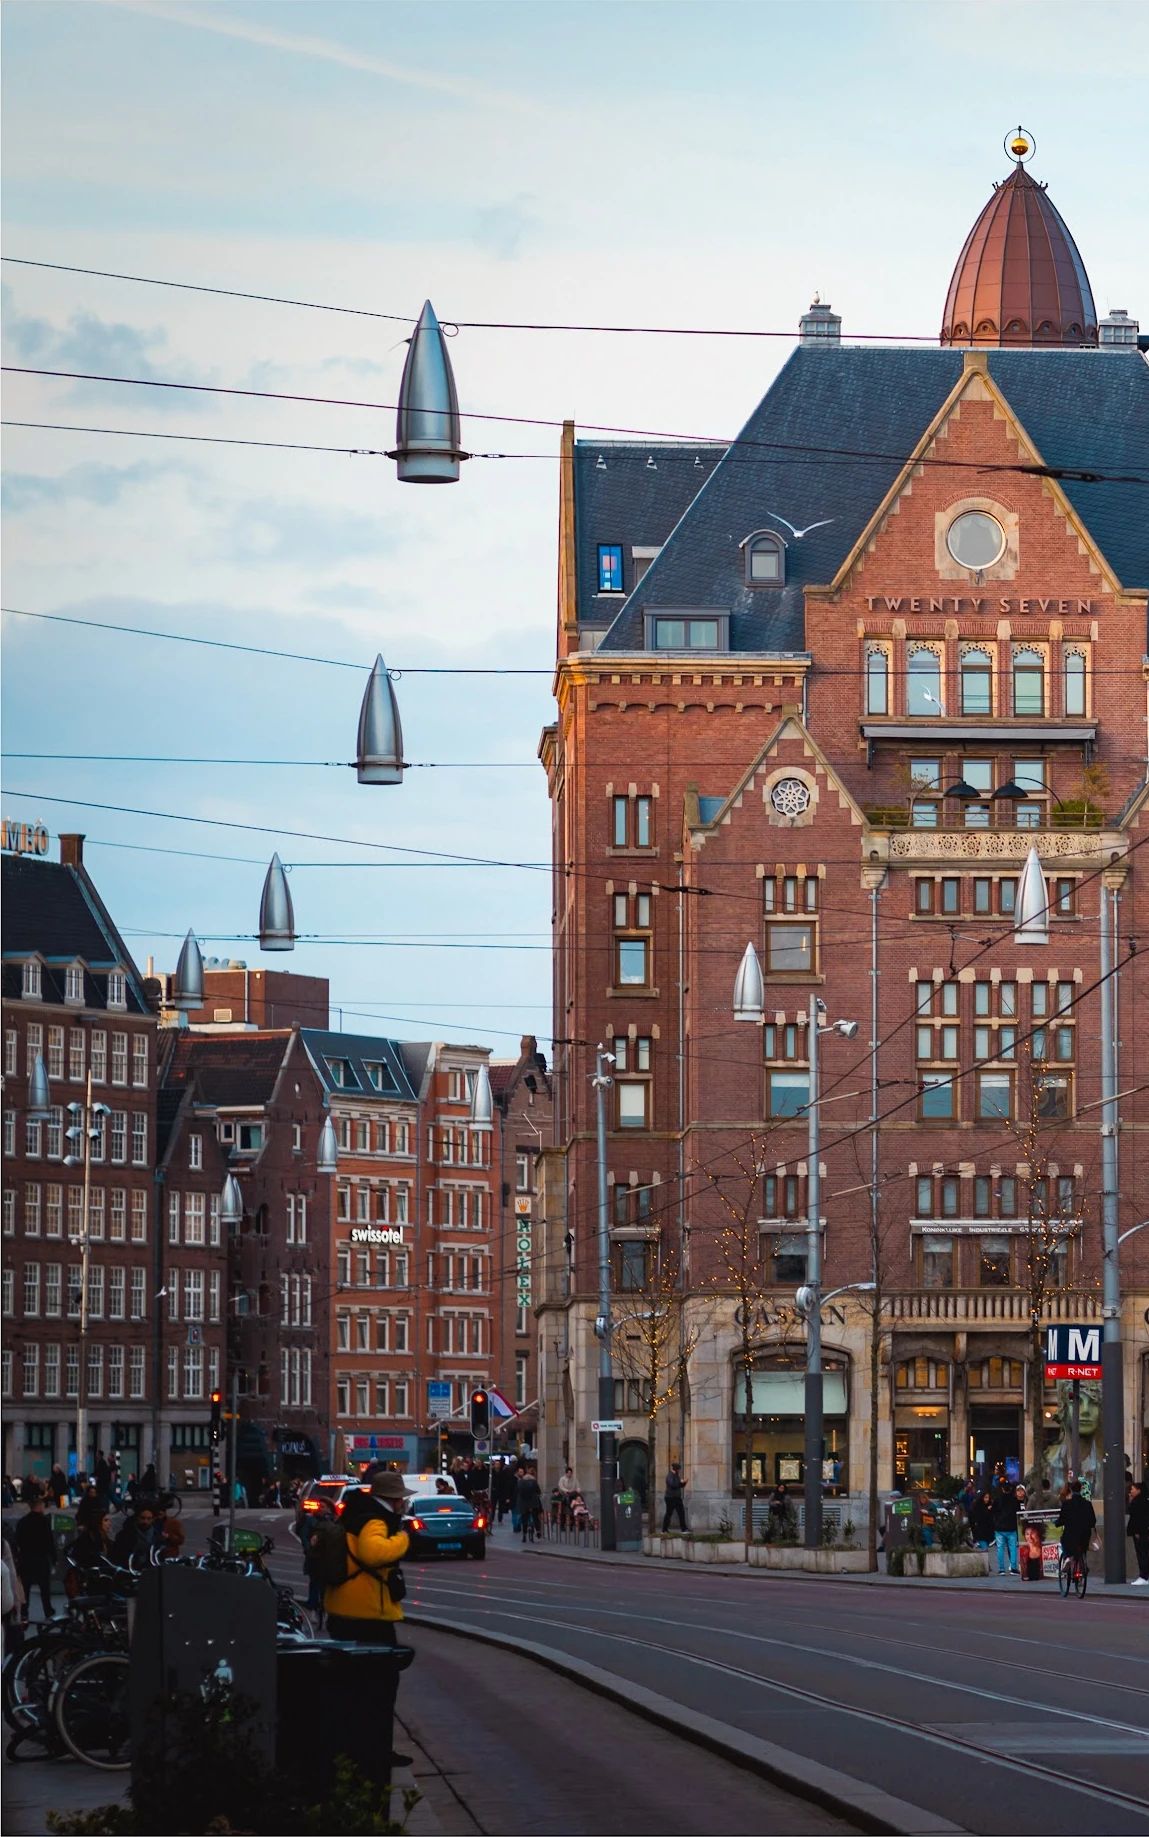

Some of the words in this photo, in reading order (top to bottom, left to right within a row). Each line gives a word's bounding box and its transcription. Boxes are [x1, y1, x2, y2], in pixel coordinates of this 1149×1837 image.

[865, 597, 982, 613] TWENTY
[1000, 597, 1092, 614] SEVEN
[734, 1305, 847, 1326] GASSN
[1048, 1328, 1058, 1361] M
[1068, 1328, 1100, 1361] M
